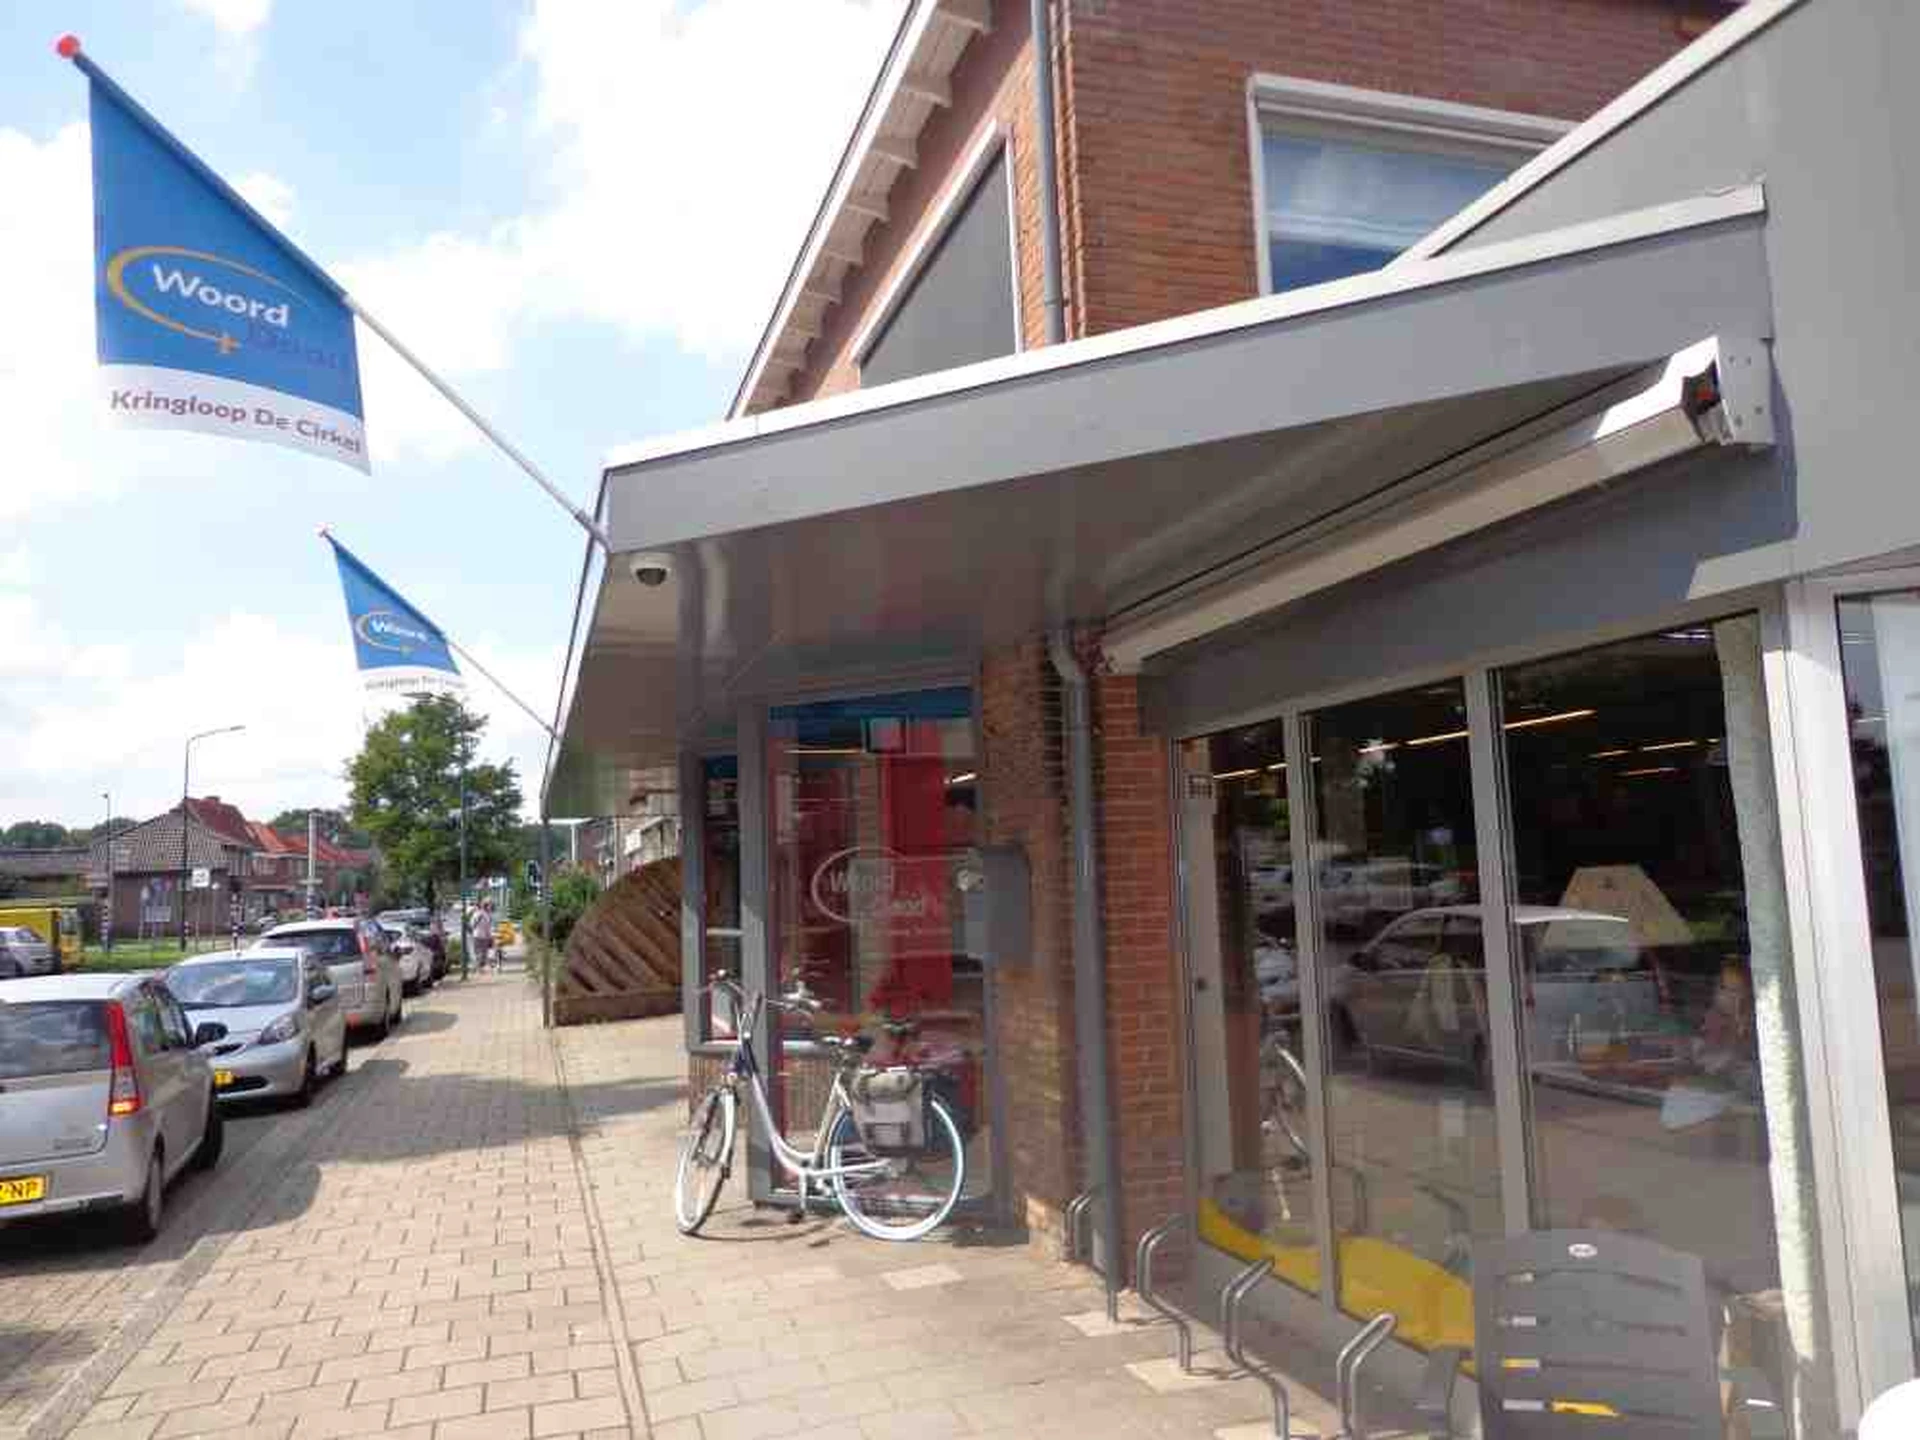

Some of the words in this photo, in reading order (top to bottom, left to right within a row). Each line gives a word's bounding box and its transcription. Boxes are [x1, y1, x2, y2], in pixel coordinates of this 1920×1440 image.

[153, 264, 289, 328] Woord
[111, 391, 247, 423] Kringloop
[254, 408, 290, 430] De
[296, 419, 361, 454] Cirkel
[0, 1180, 38, 1199] -NP
